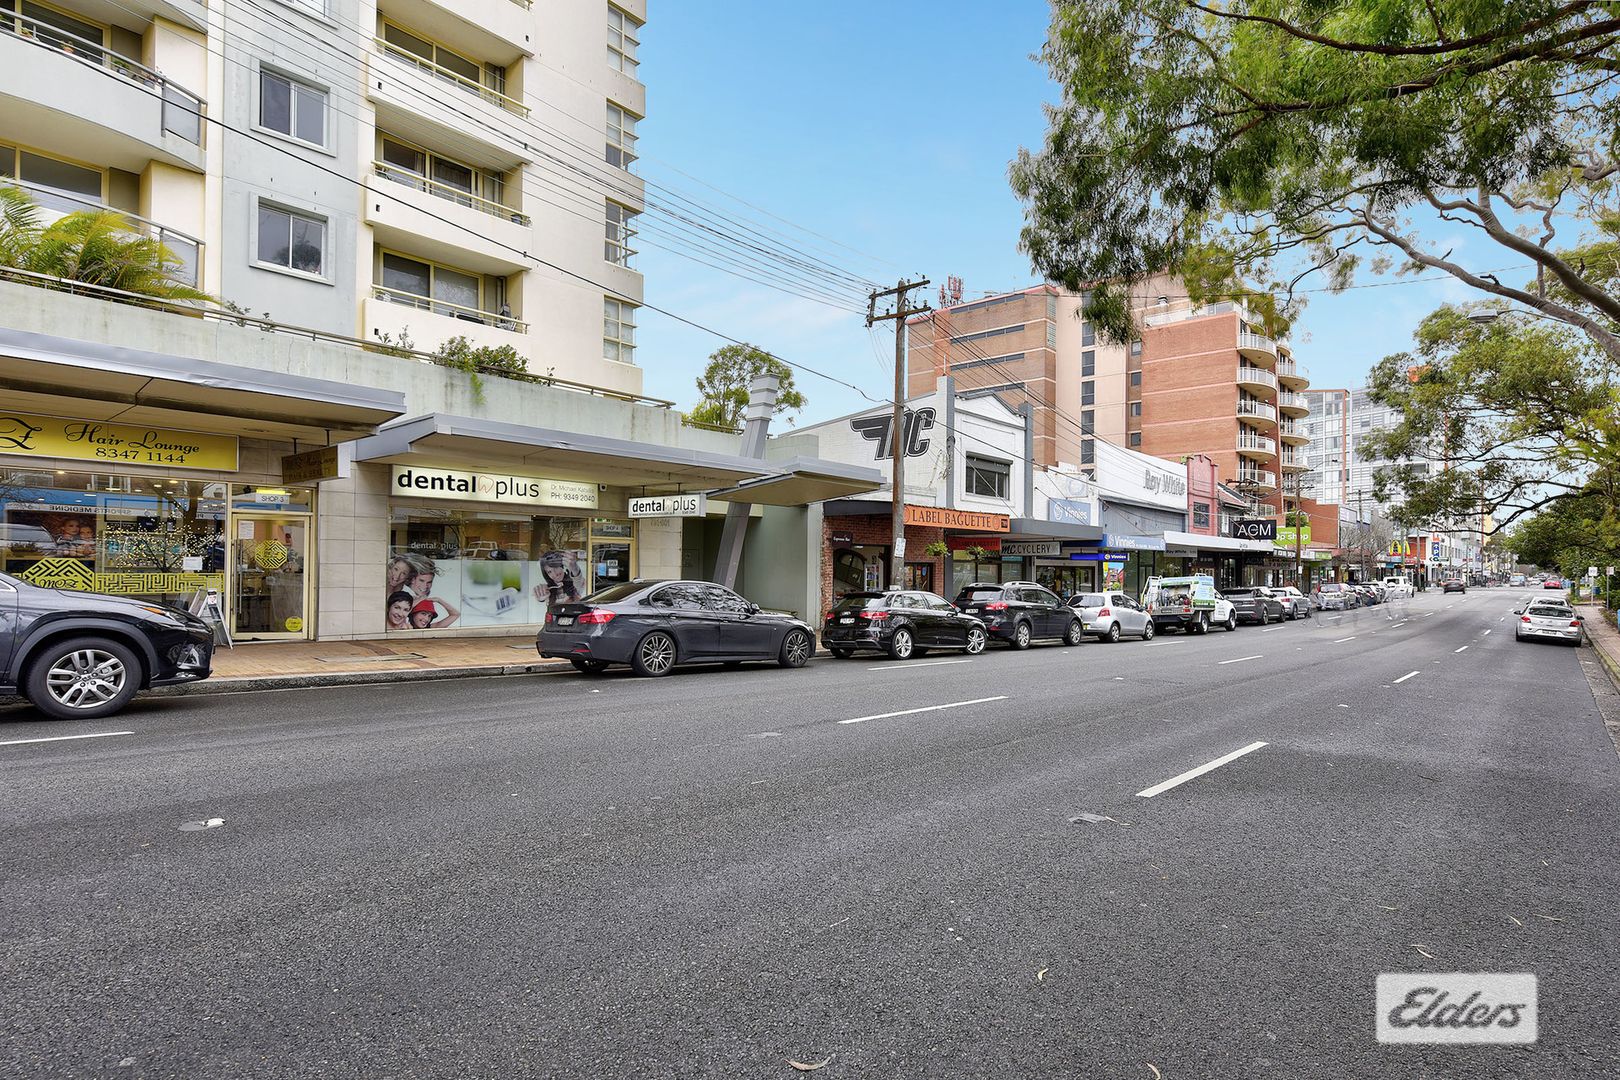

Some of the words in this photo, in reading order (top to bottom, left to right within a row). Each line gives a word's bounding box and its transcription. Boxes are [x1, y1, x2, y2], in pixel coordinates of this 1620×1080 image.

[64, 422, 124, 444] Hair
[128, 430, 200, 455] Lounge
[95, 447, 139, 460] 8347
[147, 451, 186, 463] 1144
[398, 470, 477, 492] dental
[496, 477, 540, 499] plus
[1143, 469, 1161, 495] Ray
[632, 499, 665, 513] dental
[673, 497, 697, 514] plus
[1064, 506, 1088, 520] Vinnies
[912, 509, 942, 524] LABEL
[944, 513, 991, 528] BAGUETTE
[411, 541, 437, 549] dental
[440, 541, 458, 550] plus
